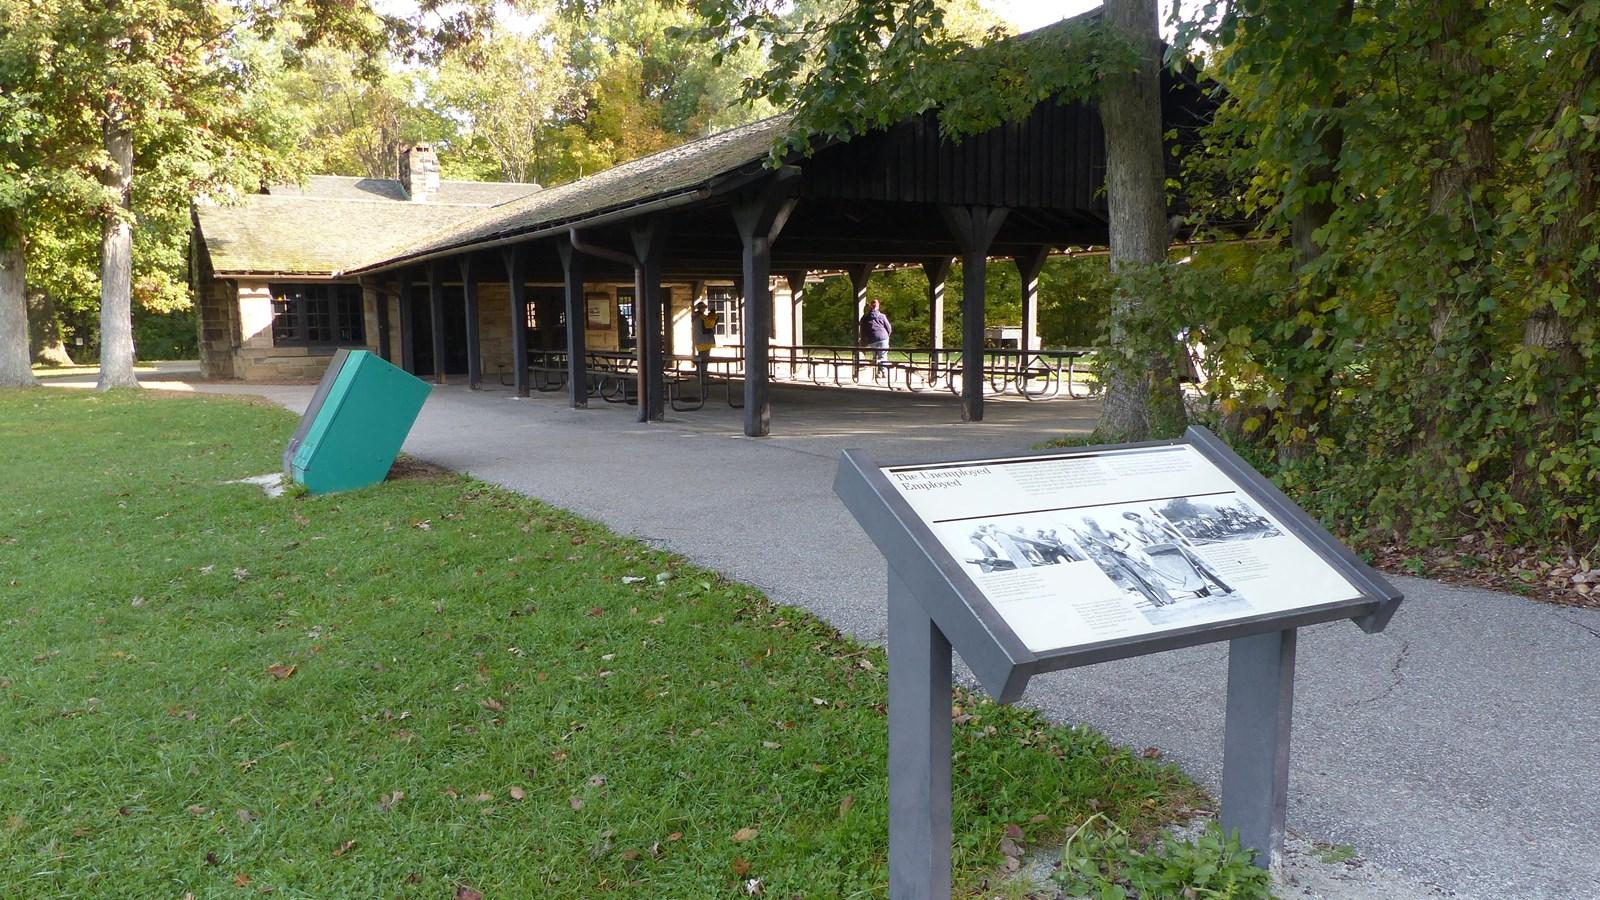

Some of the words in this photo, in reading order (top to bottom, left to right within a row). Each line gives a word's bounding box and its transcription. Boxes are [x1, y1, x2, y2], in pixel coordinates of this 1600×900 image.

[893, 472, 918, 481] The
[919, 467, 991, 479] Unemployed
[902, 479, 962, 491] Employed
